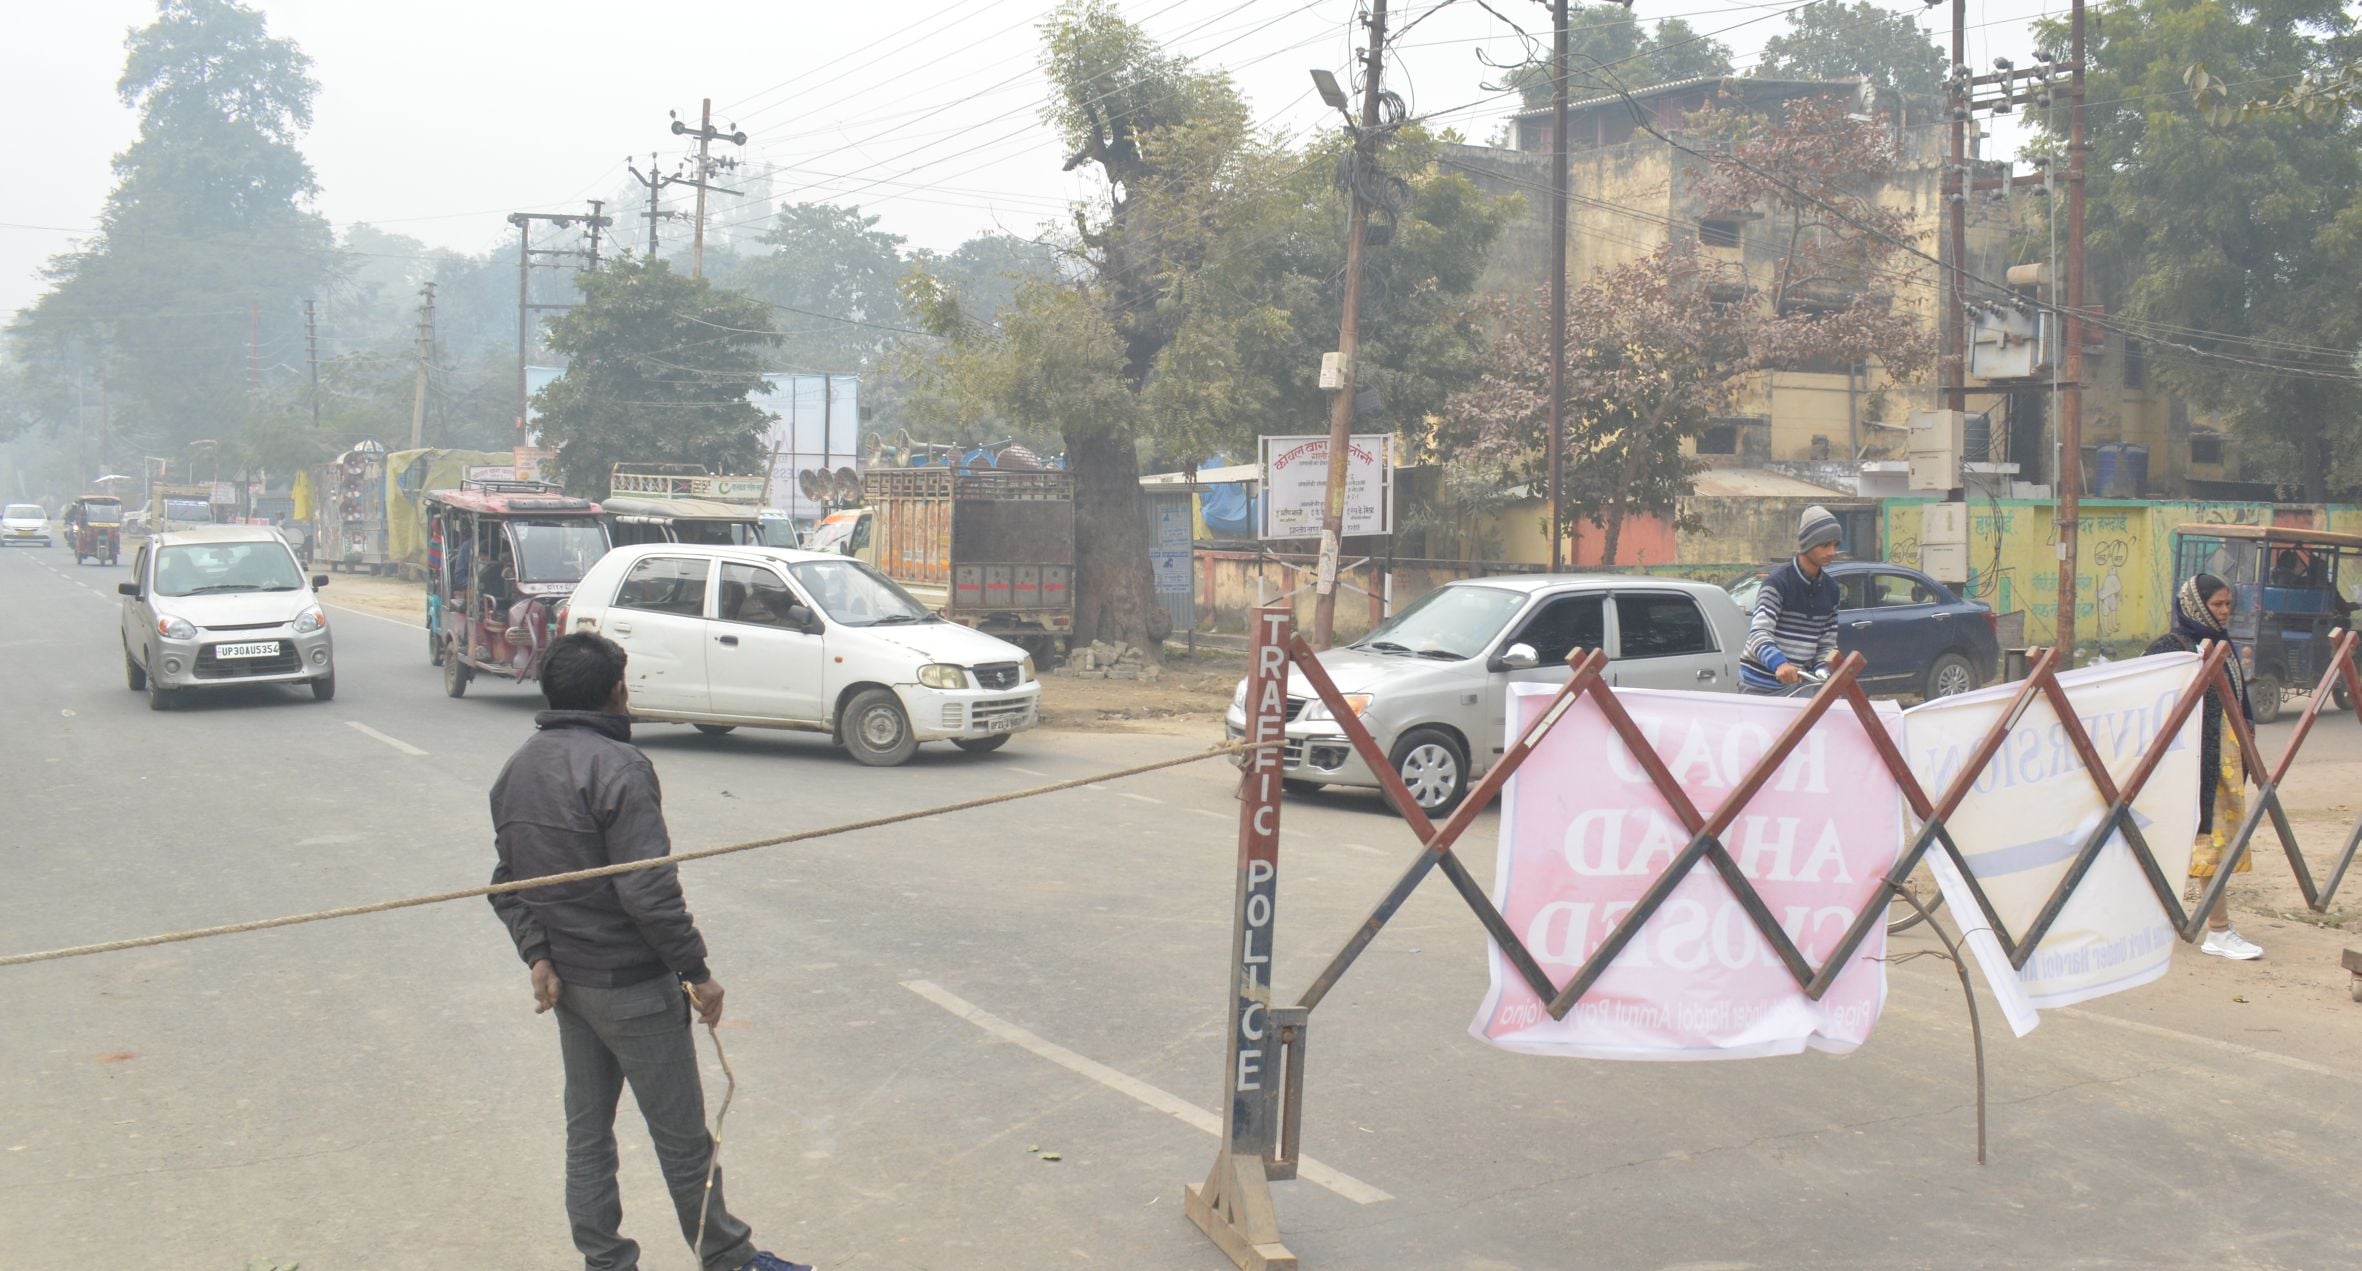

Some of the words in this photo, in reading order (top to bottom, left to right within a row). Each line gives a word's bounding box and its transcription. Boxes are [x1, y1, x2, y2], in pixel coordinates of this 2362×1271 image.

[222, 644, 279, 656] UP30AU5354
[1254, 613, 1290, 837] TRAFFIC
[1237, 860, 1274, 1092] POLICE
